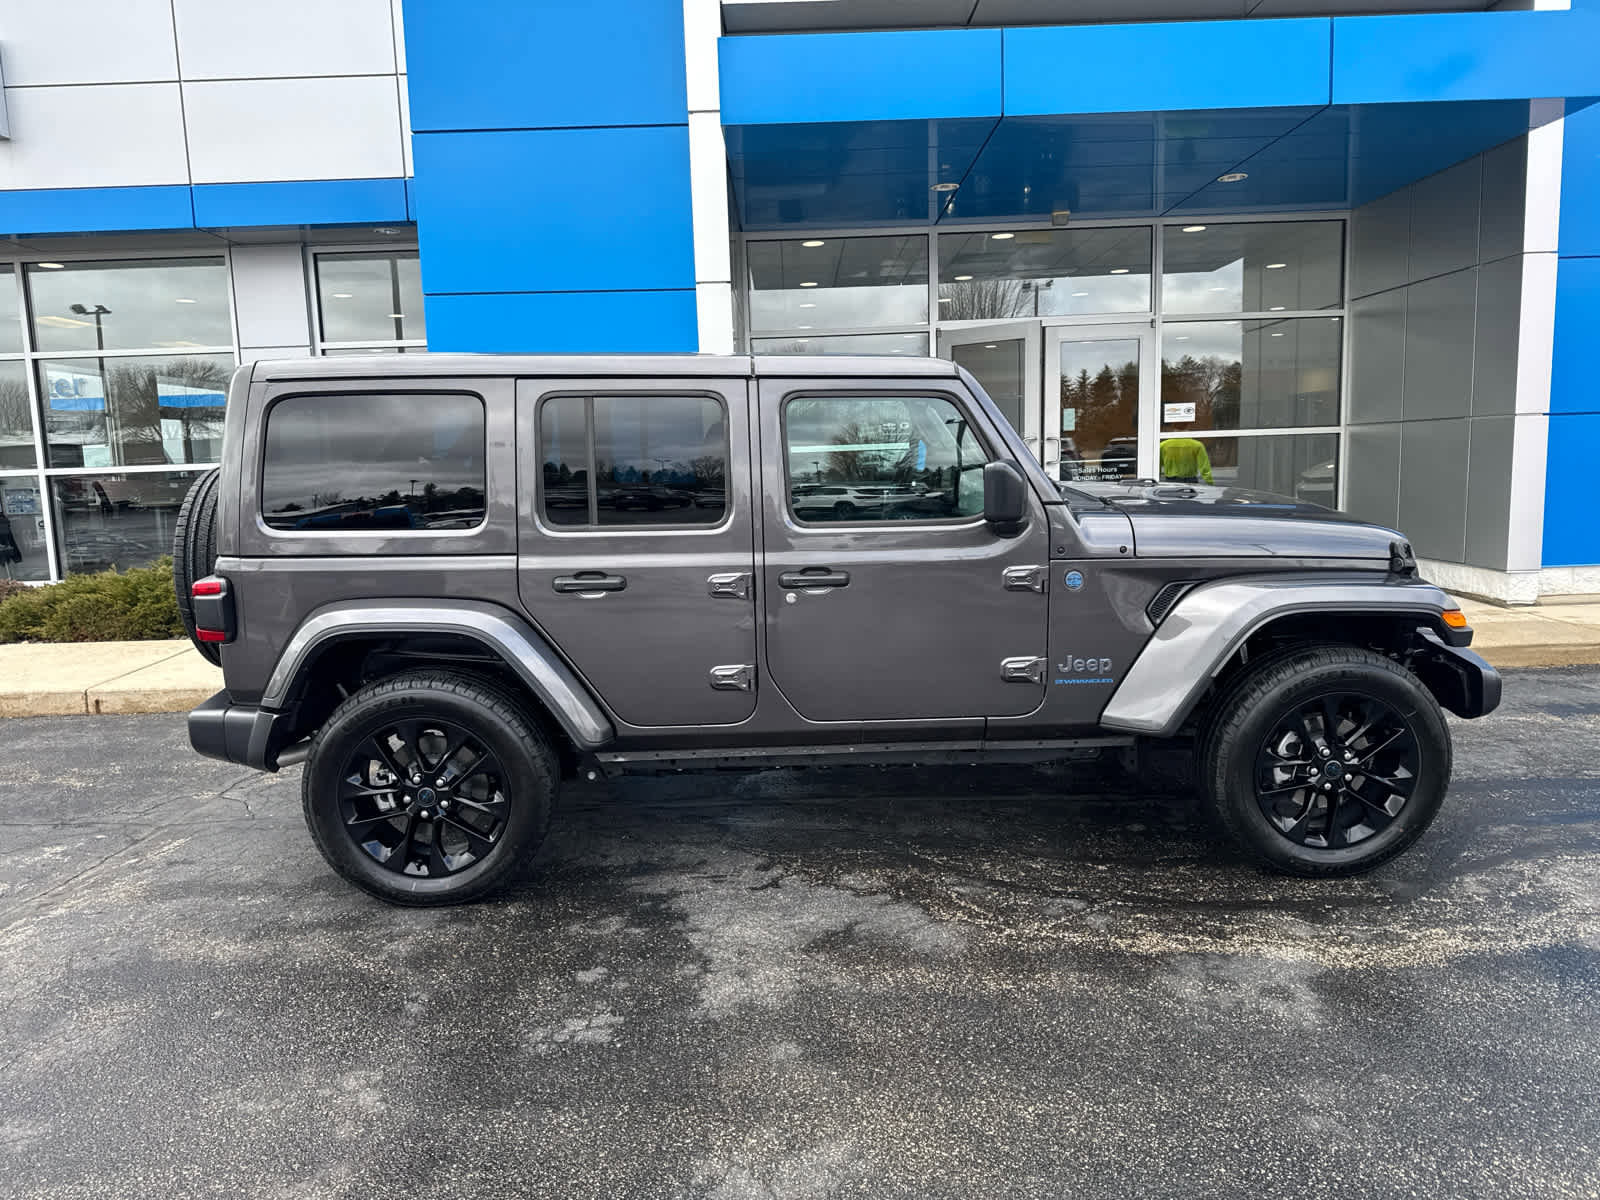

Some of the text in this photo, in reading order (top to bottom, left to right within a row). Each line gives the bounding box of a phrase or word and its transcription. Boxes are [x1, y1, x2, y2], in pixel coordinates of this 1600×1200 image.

[1078, 465, 1118, 474] Sales Hours
[1057, 654, 1112, 674] Jeep
